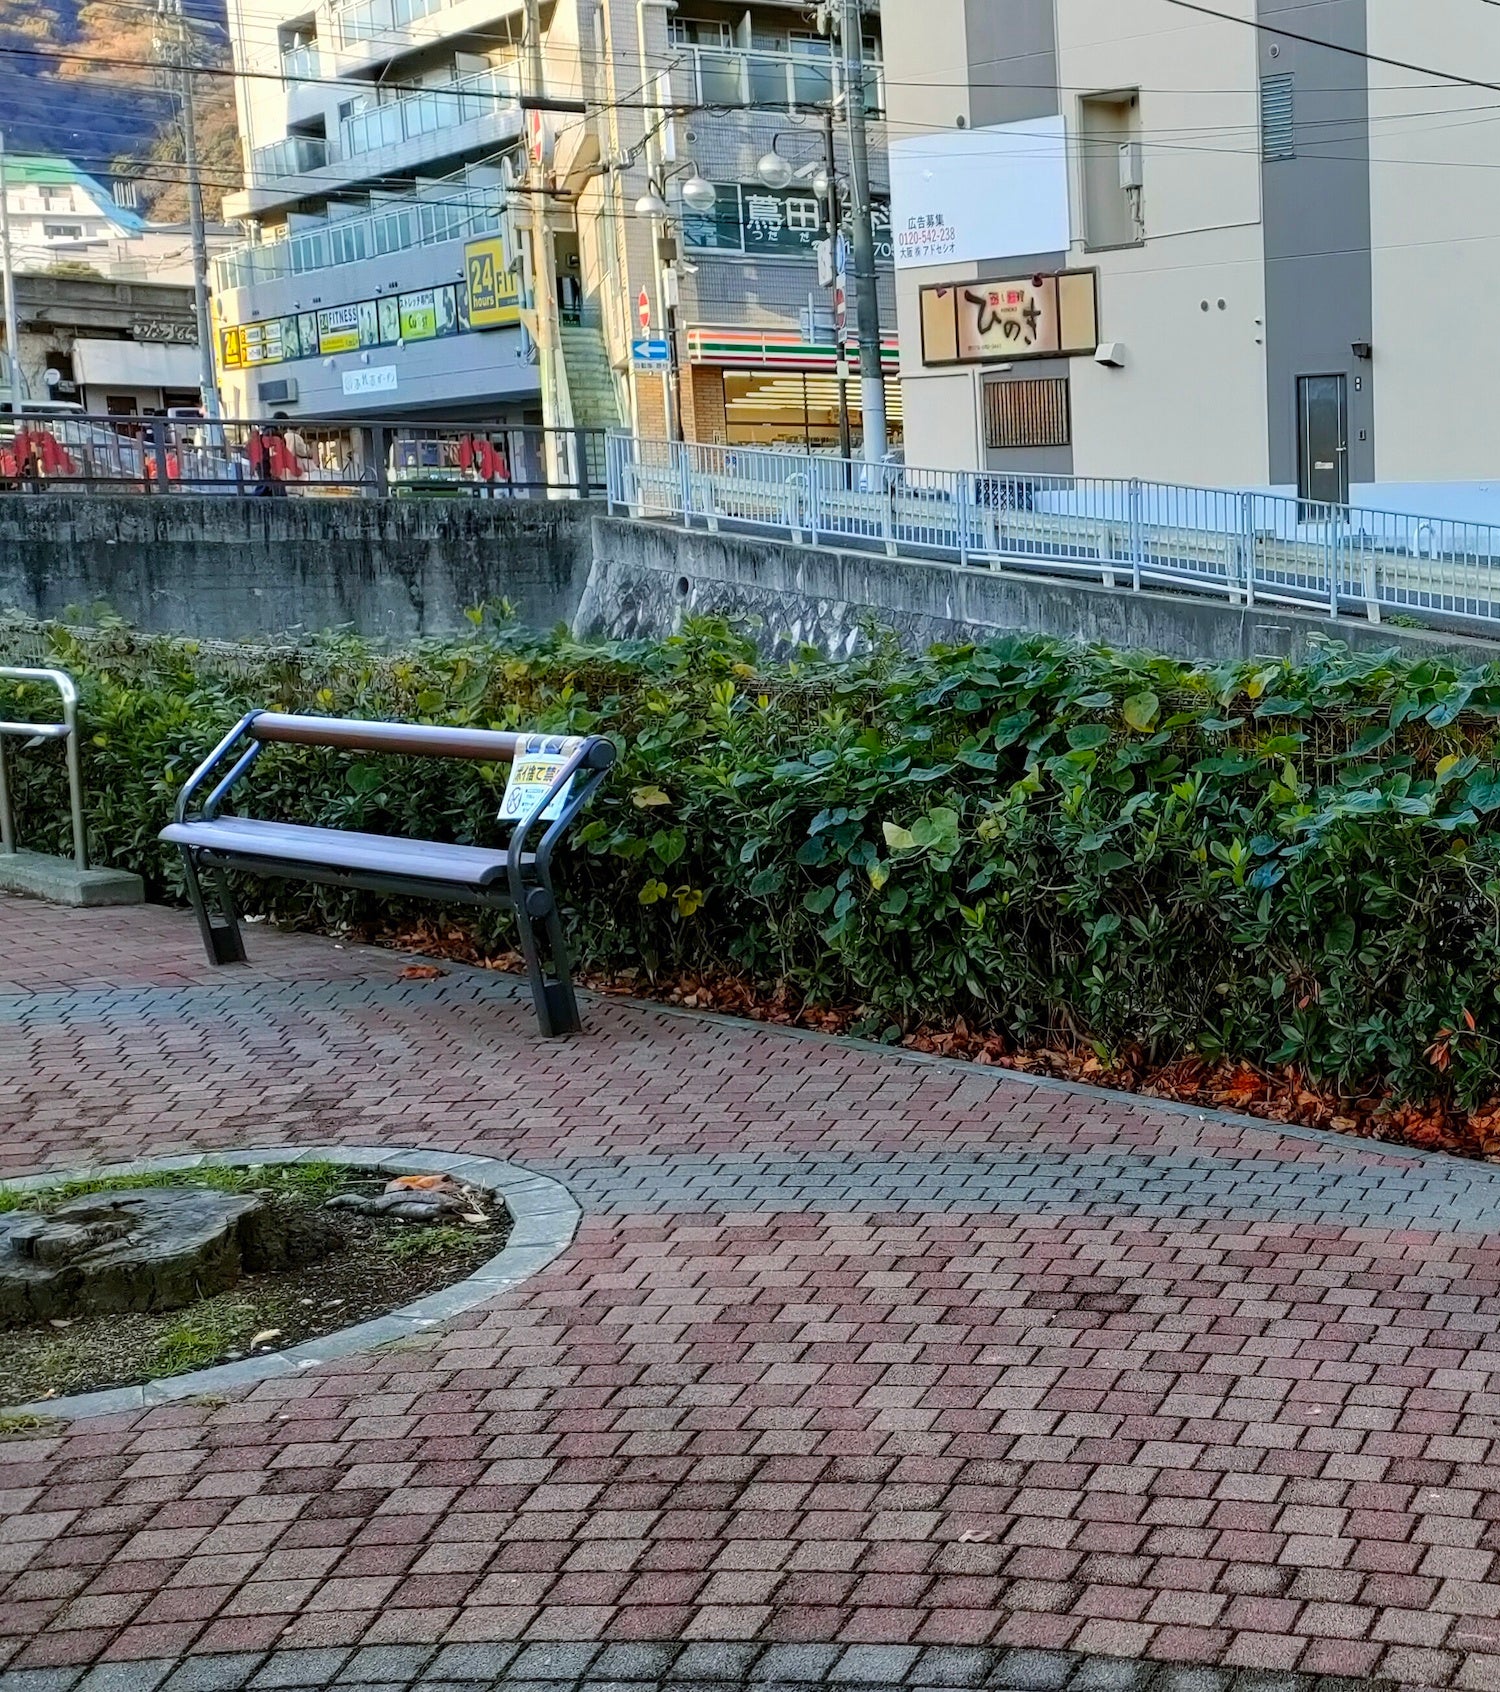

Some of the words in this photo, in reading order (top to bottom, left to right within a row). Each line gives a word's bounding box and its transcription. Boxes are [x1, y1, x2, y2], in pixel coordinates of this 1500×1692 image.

[908, 214, 945, 230] 広告募集
[899, 227, 956, 246] 0120-542-238
[471, 257, 492, 294] 24
[472, 295, 495, 308] hours
[328, 307, 357, 326] FITNESS
[964, 289, 1042, 345] ひのき
